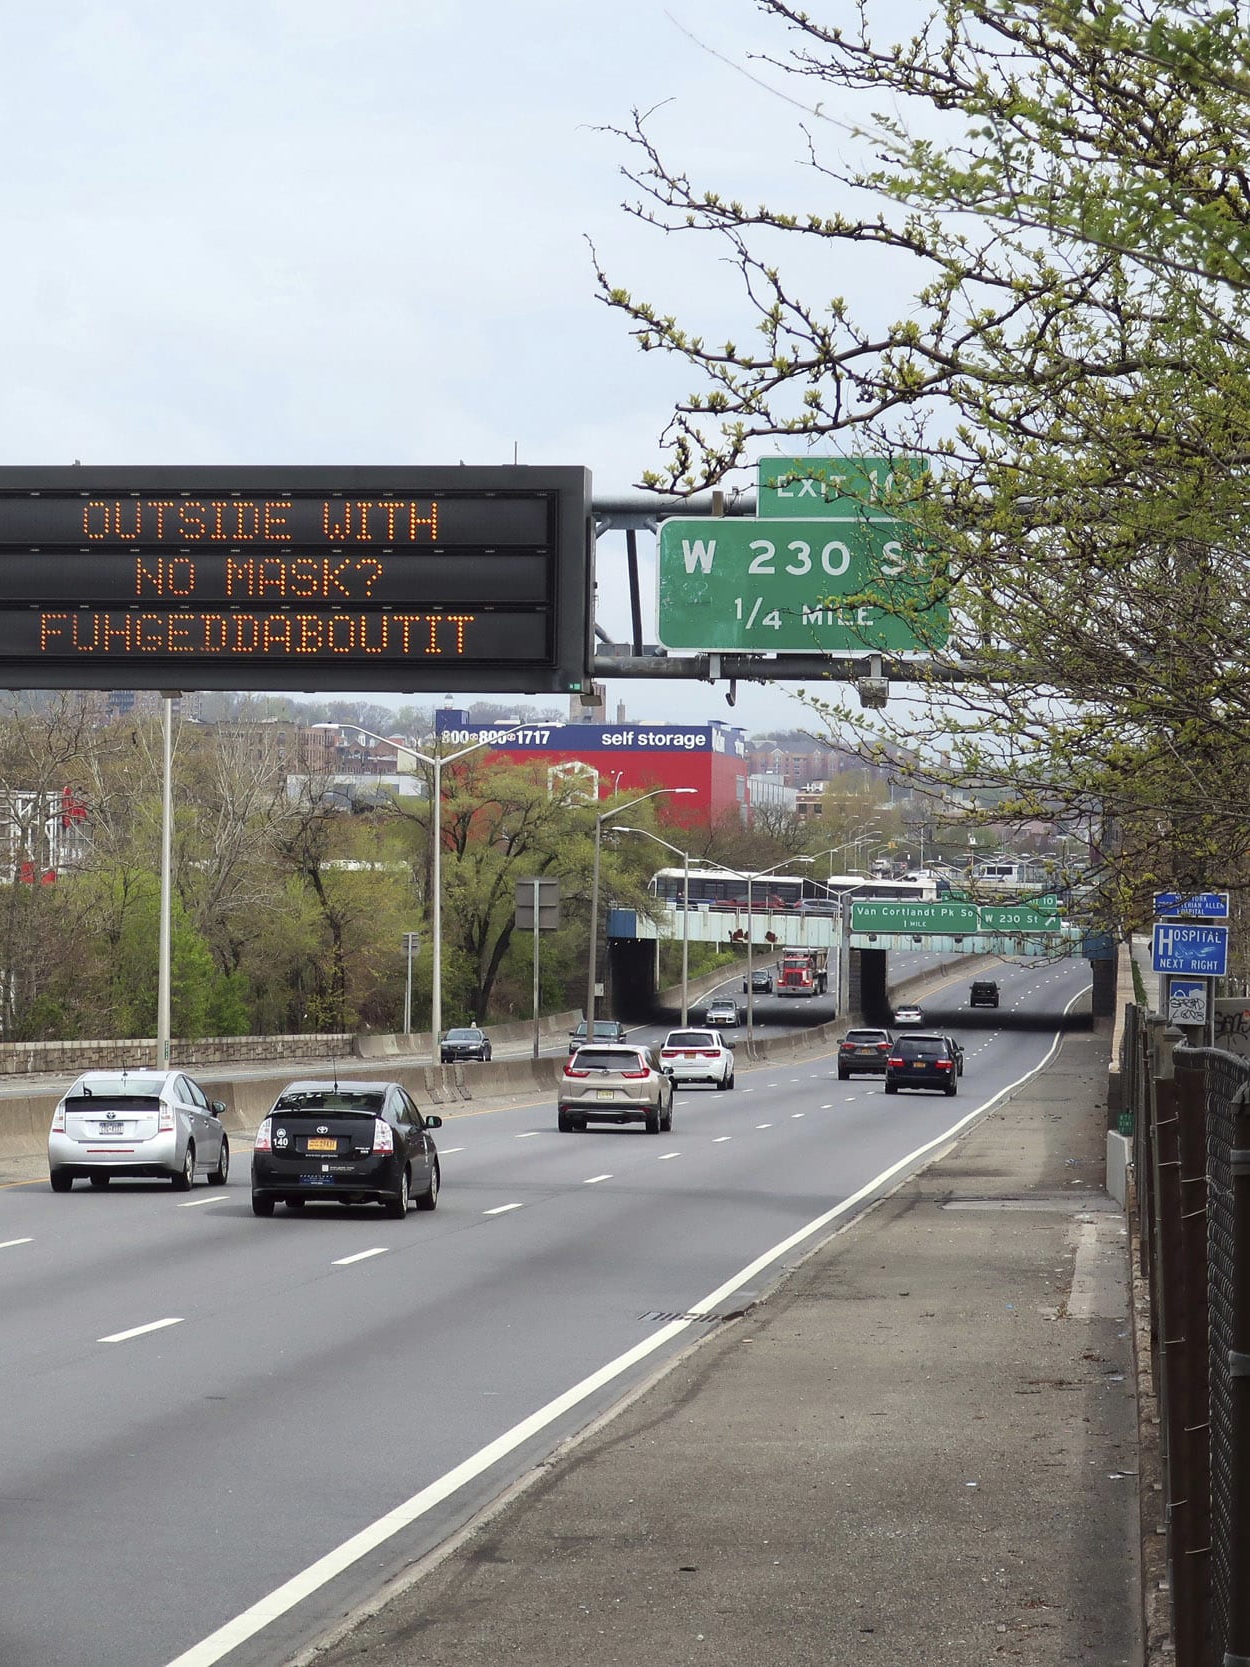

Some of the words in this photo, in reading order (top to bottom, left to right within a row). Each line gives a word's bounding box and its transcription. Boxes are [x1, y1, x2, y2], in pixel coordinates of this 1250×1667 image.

[777, 474, 847, 498] EXIT
[82, 501, 294, 540] OUTSIDE
[323, 501, 439, 540] WITH
[681, 539, 717, 574] W
[748, 540, 851, 576] 230
[135, 557, 196, 596] NO
[226, 557, 384, 598] MASK?
[734, 597, 783, 630] 1/4
[801, 604, 874, 627] MILE
[40, 613, 476, 655] FUHGEDDABOUTIT
[601, 731, 637, 747] self
[638, 731, 706, 749] storage
[856, 907, 877, 916] Van
[882, 907, 936, 917] Cortlandt
[941, 908, 955, 917] Pk
[961, 908, 974, 918] So
[1043, 897, 1054, 905] 10
[984, 914, 994, 923] W
[999, 914, 1021, 924] 230
[1026, 915, 1039, 924] St
[1158, 928, 1222, 956] HOSPITAL
[1159, 958, 1184, 969] NEXT
[1191, 960, 1219, 971] RIGHT
[272, 1137, 289, 1146] 140
